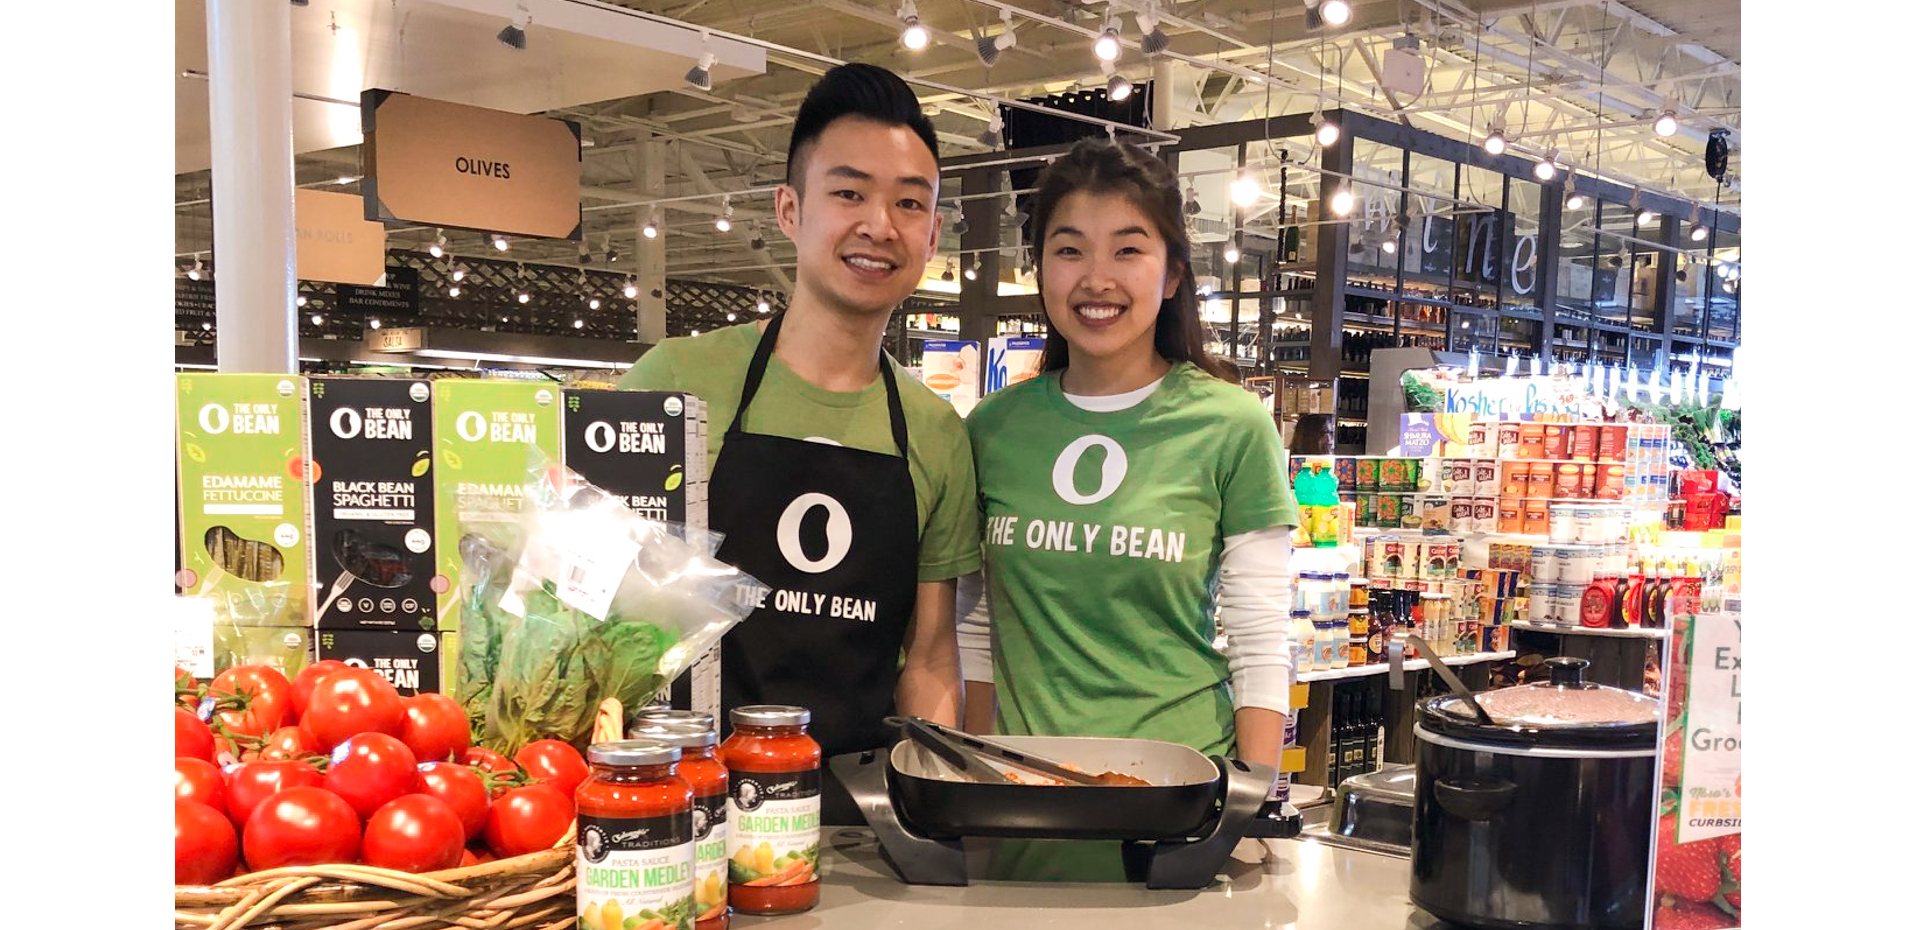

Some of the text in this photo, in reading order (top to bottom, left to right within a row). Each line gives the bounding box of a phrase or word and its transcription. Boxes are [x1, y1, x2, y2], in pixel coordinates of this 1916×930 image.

[456, 157, 510, 179] OLIVES
[233, 403, 278, 415] THE ONLY
[365, 408, 411, 420] THE ONLY
[233, 414, 280, 434] BEAN
[492, 411, 536, 424] THE ONLY
[365, 419, 413, 440] BEAN
[490, 423, 537, 444] BEAN
[620, 421, 665, 434] THE ONLY
[619, 433, 666, 454] BEAN
[203, 475, 283, 489] EDAMAME
[332, 481, 415, 494] BLACK BEAN
[203, 489, 283, 502] FETTUCCINE
[333, 494, 415, 507] SPAGHETTI
[632, 496, 667, 508] BEAN
[986, 516, 1186, 563] THE ONLY BEAN
[736, 584, 877, 622] THE ONLY BEAN
[373, 658, 419, 669] THE ONLY
[1692, 727, 1741, 751] Gro
[766, 807, 789, 815] PASTA
[738, 815, 789, 833] GARDEN
[622, 836, 681, 849] TRADITIONS
[611, 855, 669, 867] PASTA SAUCE
[585, 866, 640, 889] GARDEN
